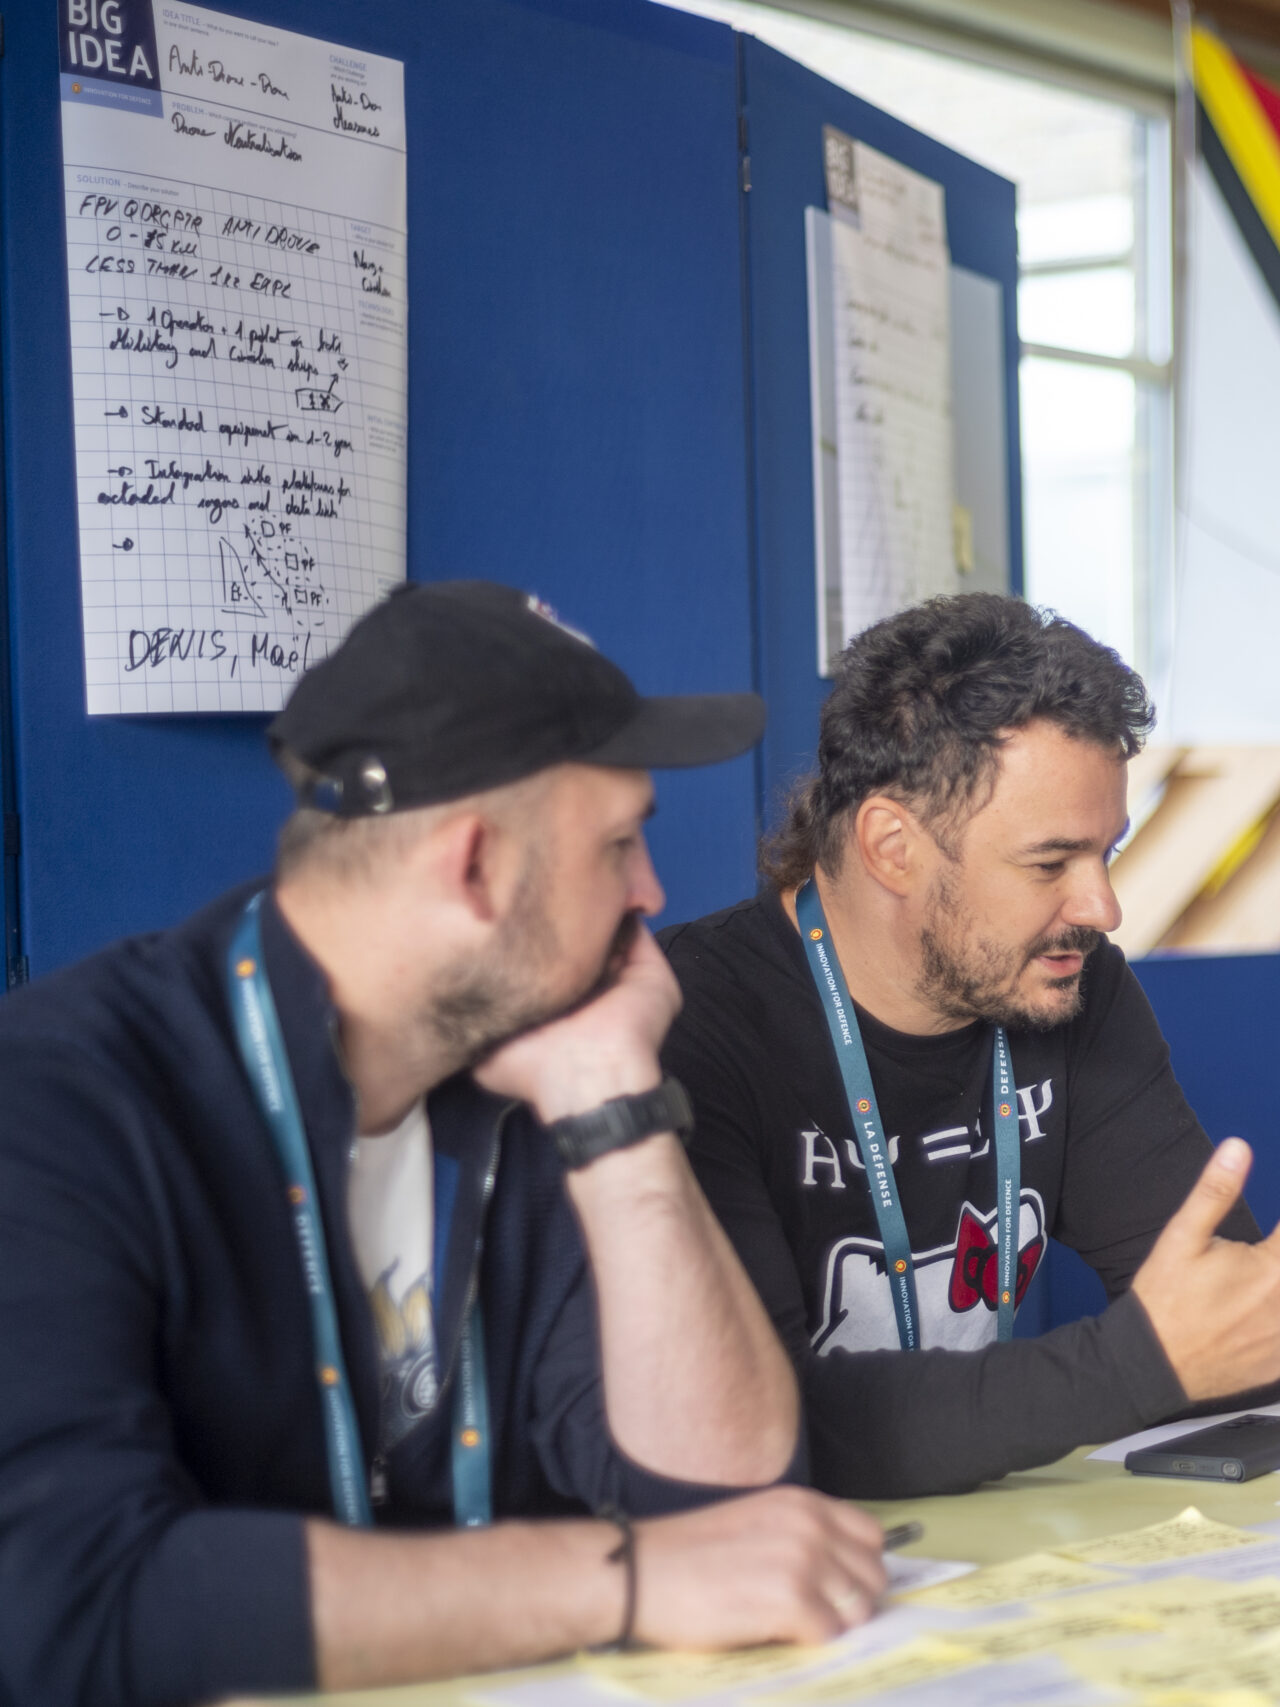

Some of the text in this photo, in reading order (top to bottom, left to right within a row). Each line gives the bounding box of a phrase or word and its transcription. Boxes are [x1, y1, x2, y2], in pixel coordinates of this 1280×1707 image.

[68, 0, 122, 34] BIG
[180, 14, 200, 25] TITLE
[69, 31, 153, 80] IDEA
[76, 174, 120, 187] SOLUTION
[79, 194, 118, 217] FPV
[816, 943, 852, 1046] INNOVATION FOR DEFENCE
[996, 1027, 1010, 1094] DEFENSIE
[864, 1121, 892, 1208] LA DÉFENSE
[899, 1276, 912, 1331] INNOVATION
[906, 1331, 915, 1346] FOR
